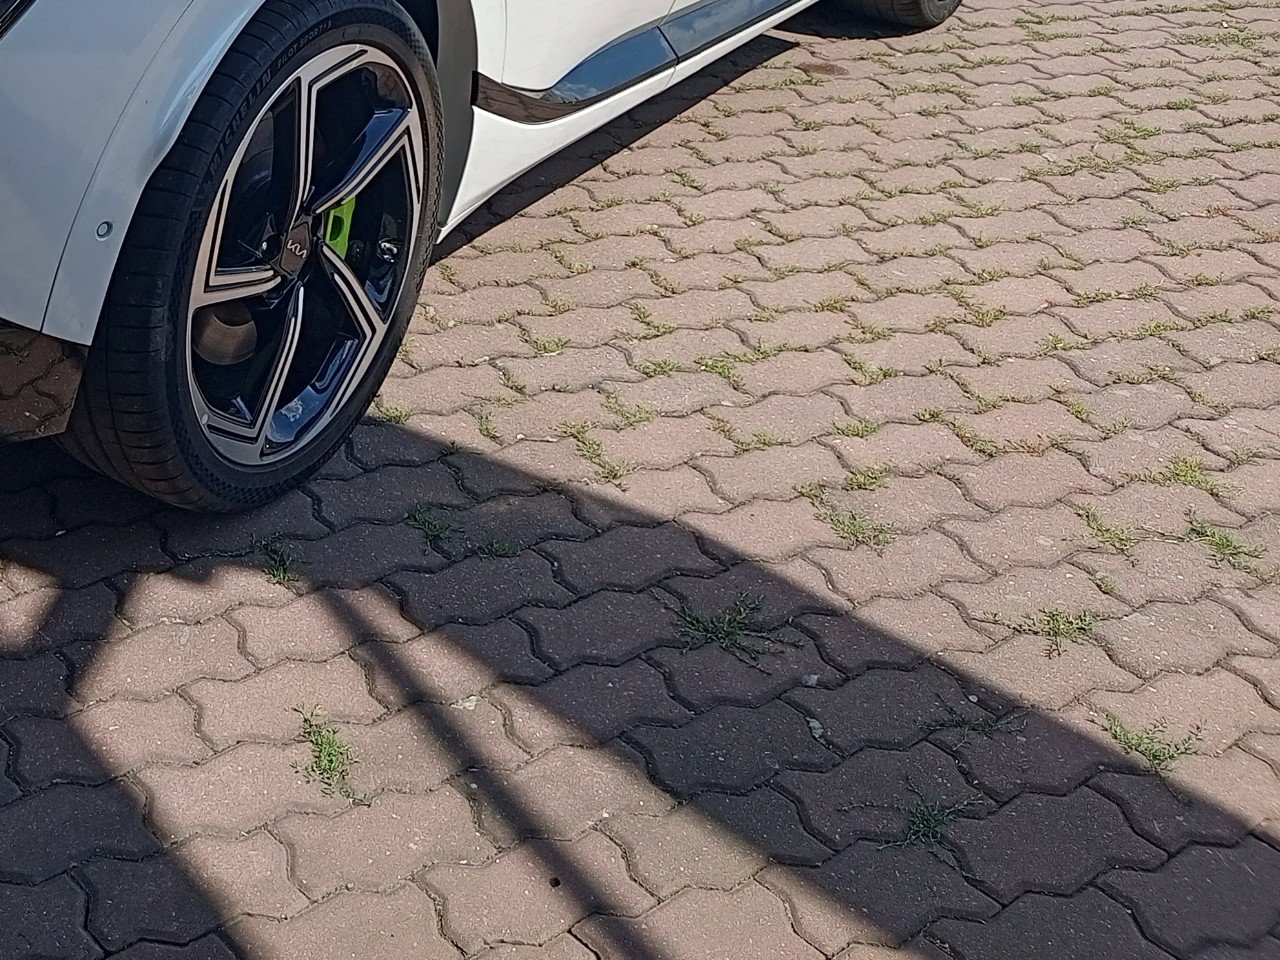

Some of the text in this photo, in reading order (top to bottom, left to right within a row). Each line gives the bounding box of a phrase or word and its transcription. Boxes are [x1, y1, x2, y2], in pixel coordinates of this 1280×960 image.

[207, 68, 271, 178] MICHELIN
[276, 43, 298, 69] PILOT
[287, 239, 308, 259] KIA
